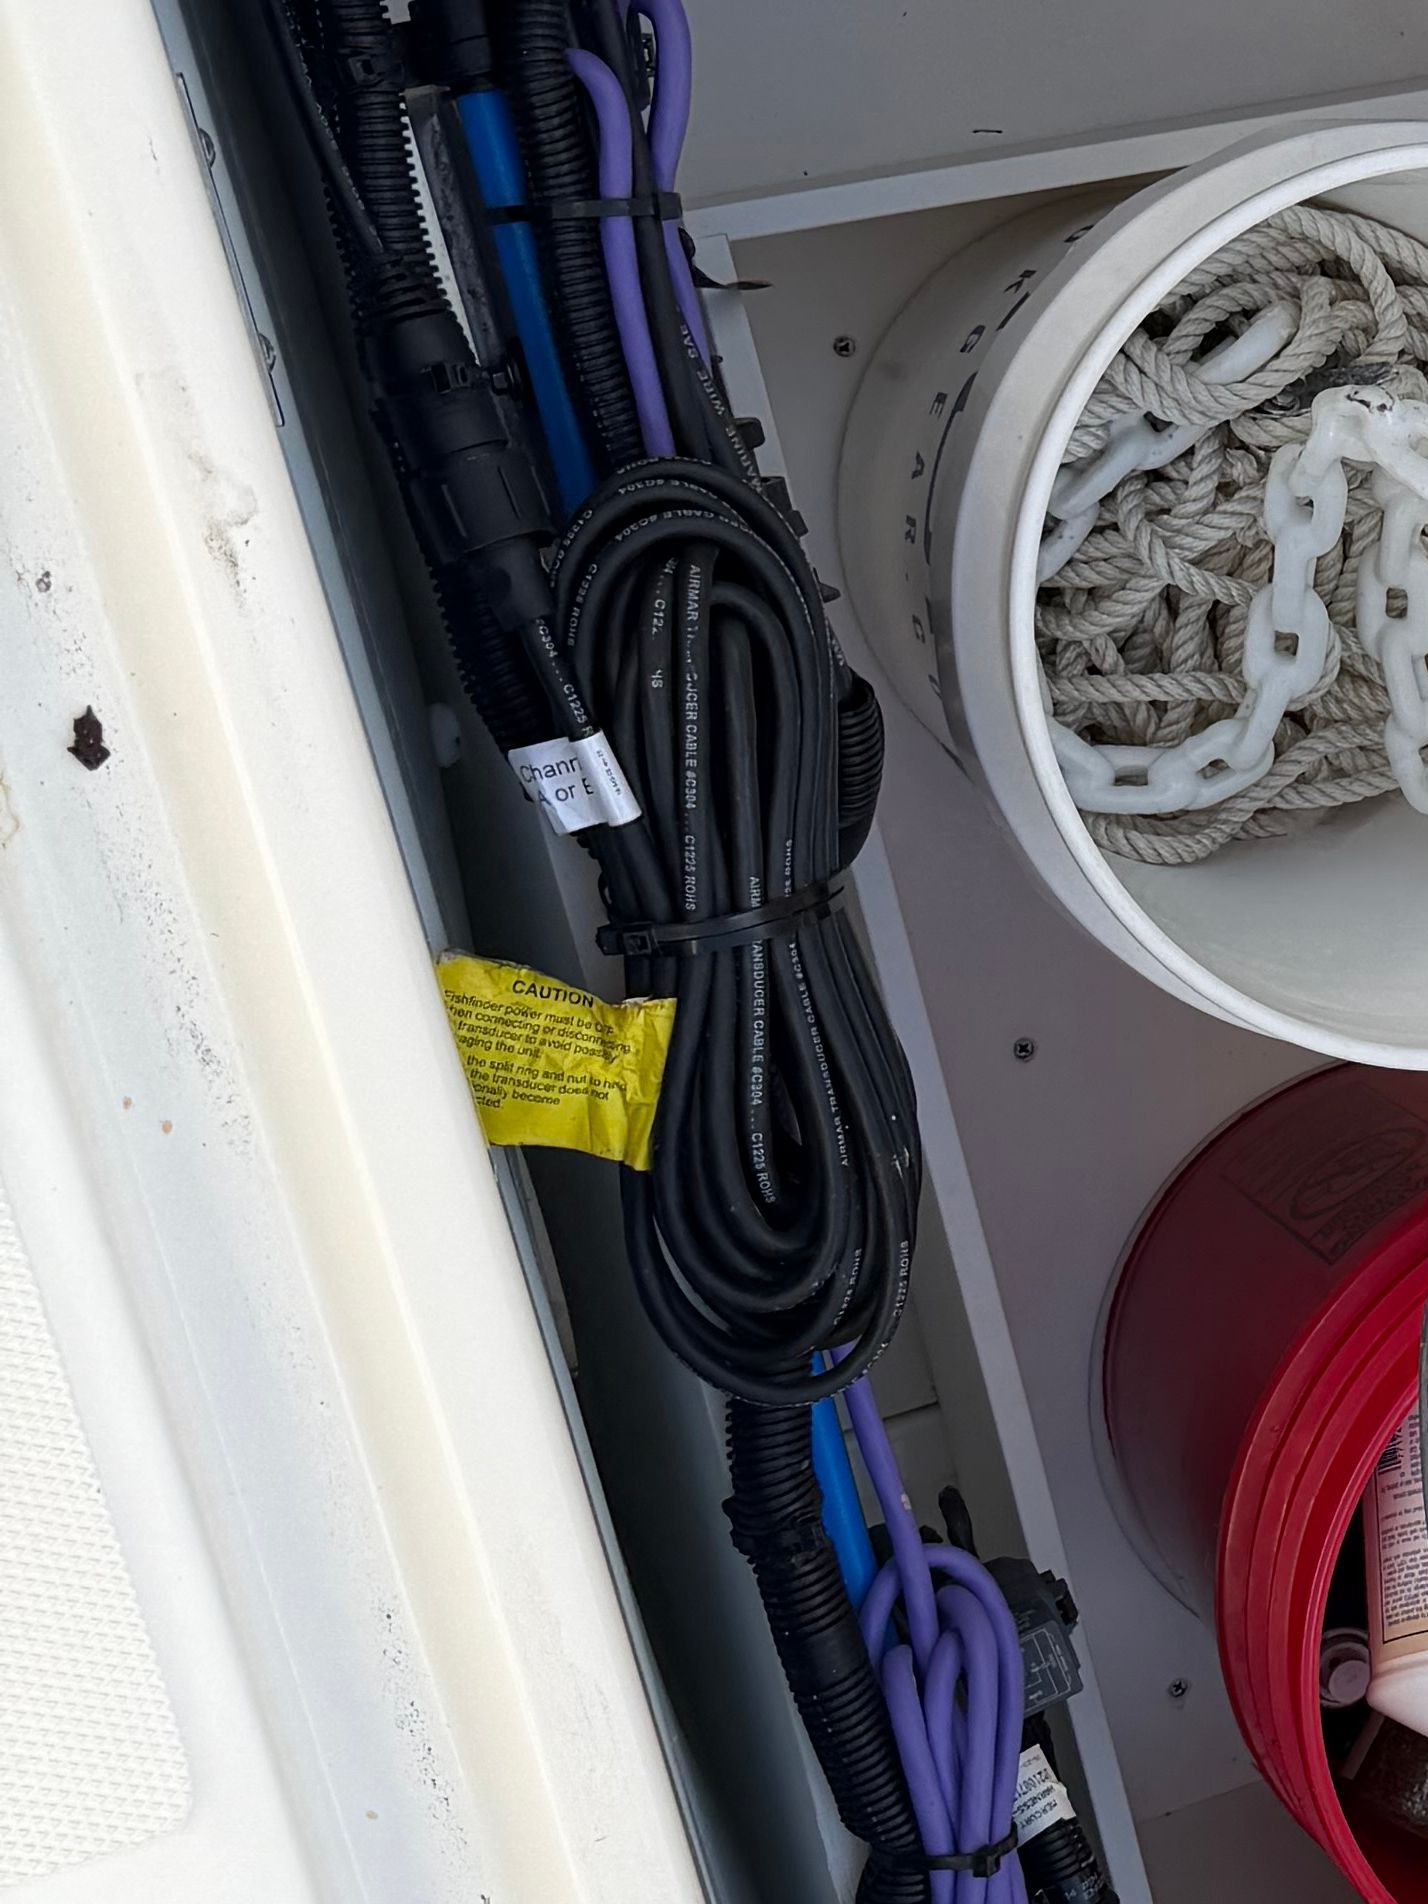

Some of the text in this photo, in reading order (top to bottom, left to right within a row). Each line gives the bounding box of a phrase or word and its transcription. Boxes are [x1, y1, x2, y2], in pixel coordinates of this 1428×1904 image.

[686, 563, 702, 622] AIRMAR
[562, 683, 588, 725] C1225
[685, 722, 699, 768] CABLE
[518, 756, 582, 783] Chann
[554, 783, 576, 802] or
[511, 978, 595, 1008] CAUTION
[474, 1011, 540, 1035] connecting
[542, 1025, 554, 1034] or
[504, 1005, 542, 1021] power
[544, 1012, 574, 1027] must
[576, 1018, 592, 1030] be
[457, 1021, 522, 1043] transducer
[525, 1034, 537, 1045] to
[538, 1036, 571, 1051] avoid
[494, 1041, 514, 1053] the
[466, 1055, 486, 1068] the
[488, 1059, 514, 1074] split
[515, 1064, 539, 1079] ring
[542, 1067, 565, 1082] and
[567, 1072, 586, 1084] nut
[588, 1076, 600, 1087] to
[469, 1069, 489, 1081] the
[491, 1073, 556, 1093] transducer
[511, 1090, 560, 1106] become
[757, 1171, 776, 1204] ROHS
